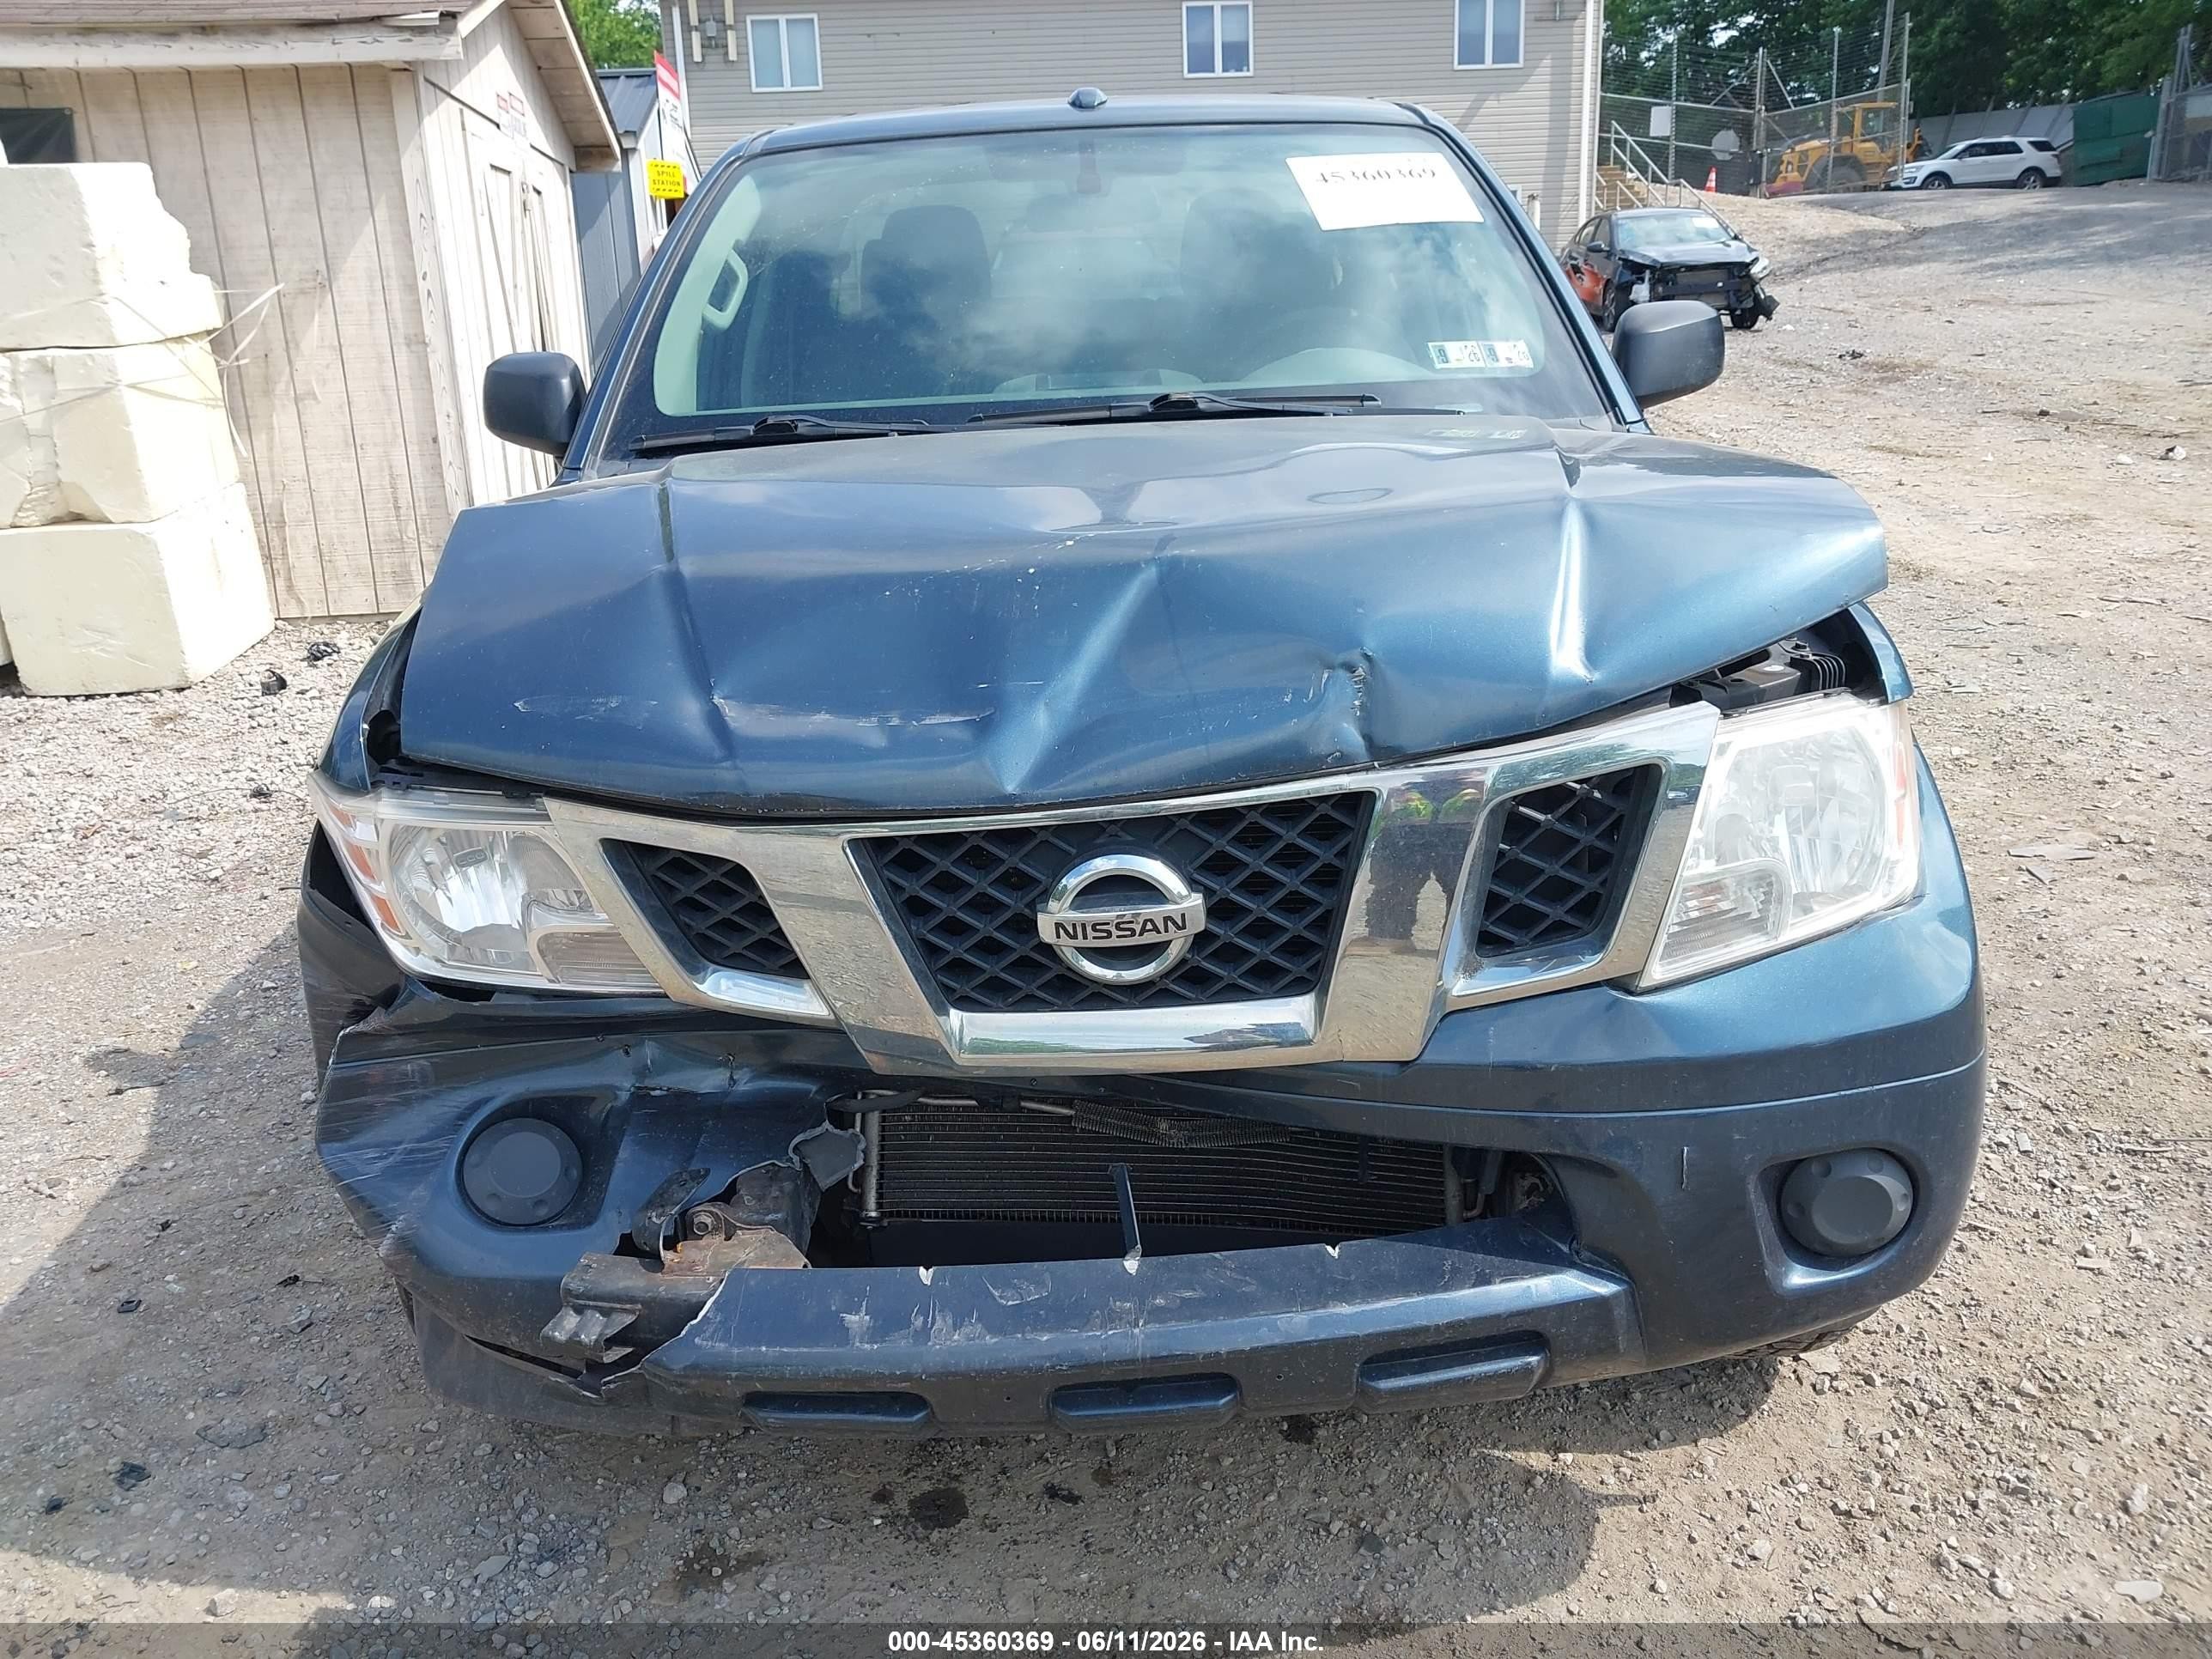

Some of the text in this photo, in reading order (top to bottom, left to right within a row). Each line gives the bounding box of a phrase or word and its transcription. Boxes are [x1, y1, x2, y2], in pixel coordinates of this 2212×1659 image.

[653, 179, 681, 187] STATION
[1316, 167, 1437, 184] 45360369
[1054, 912, 1188, 941] NISSAN
